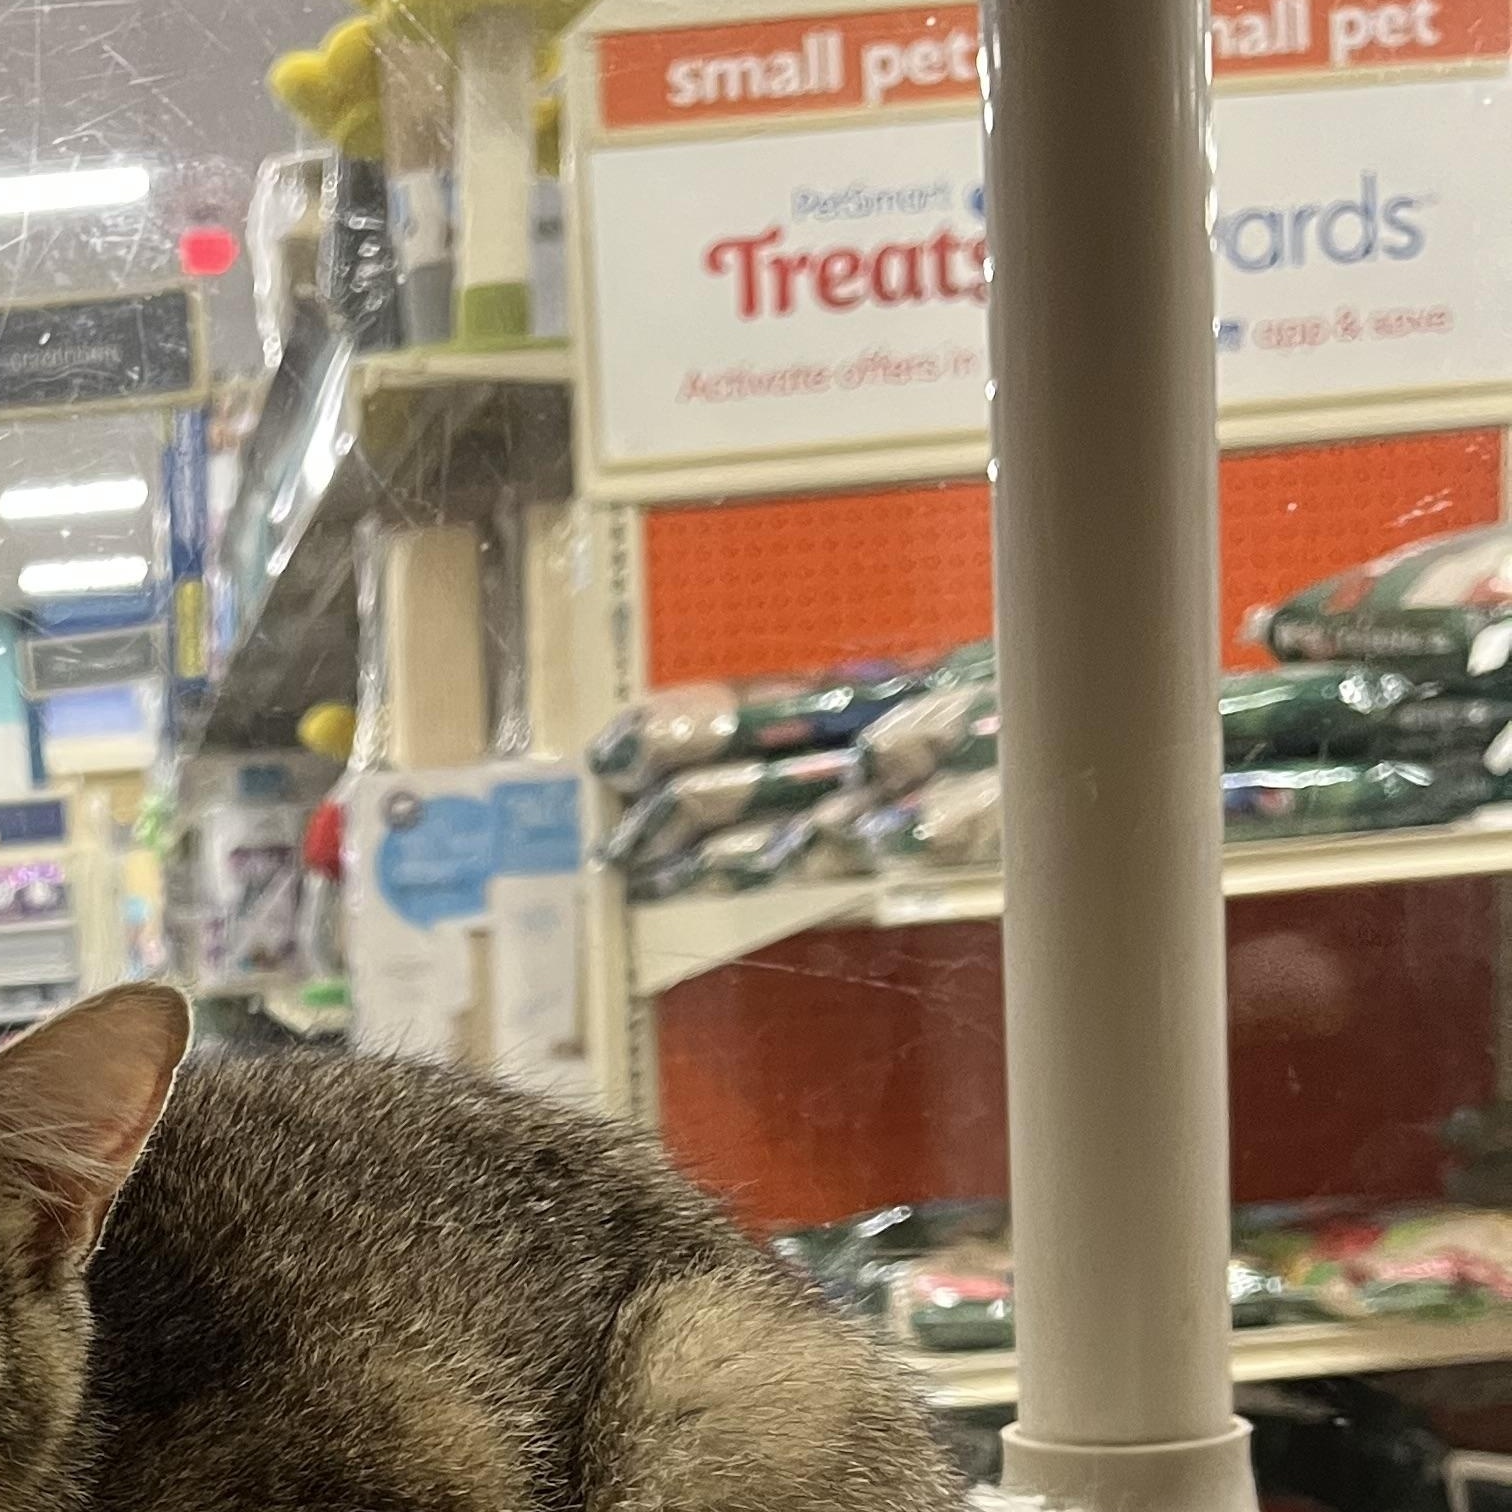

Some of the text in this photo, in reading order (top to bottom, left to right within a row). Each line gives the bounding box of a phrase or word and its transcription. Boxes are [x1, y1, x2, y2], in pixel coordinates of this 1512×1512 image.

[666, 0, 1442, 109] small pet all pet
[1216, 170, 1425, 272] ards
